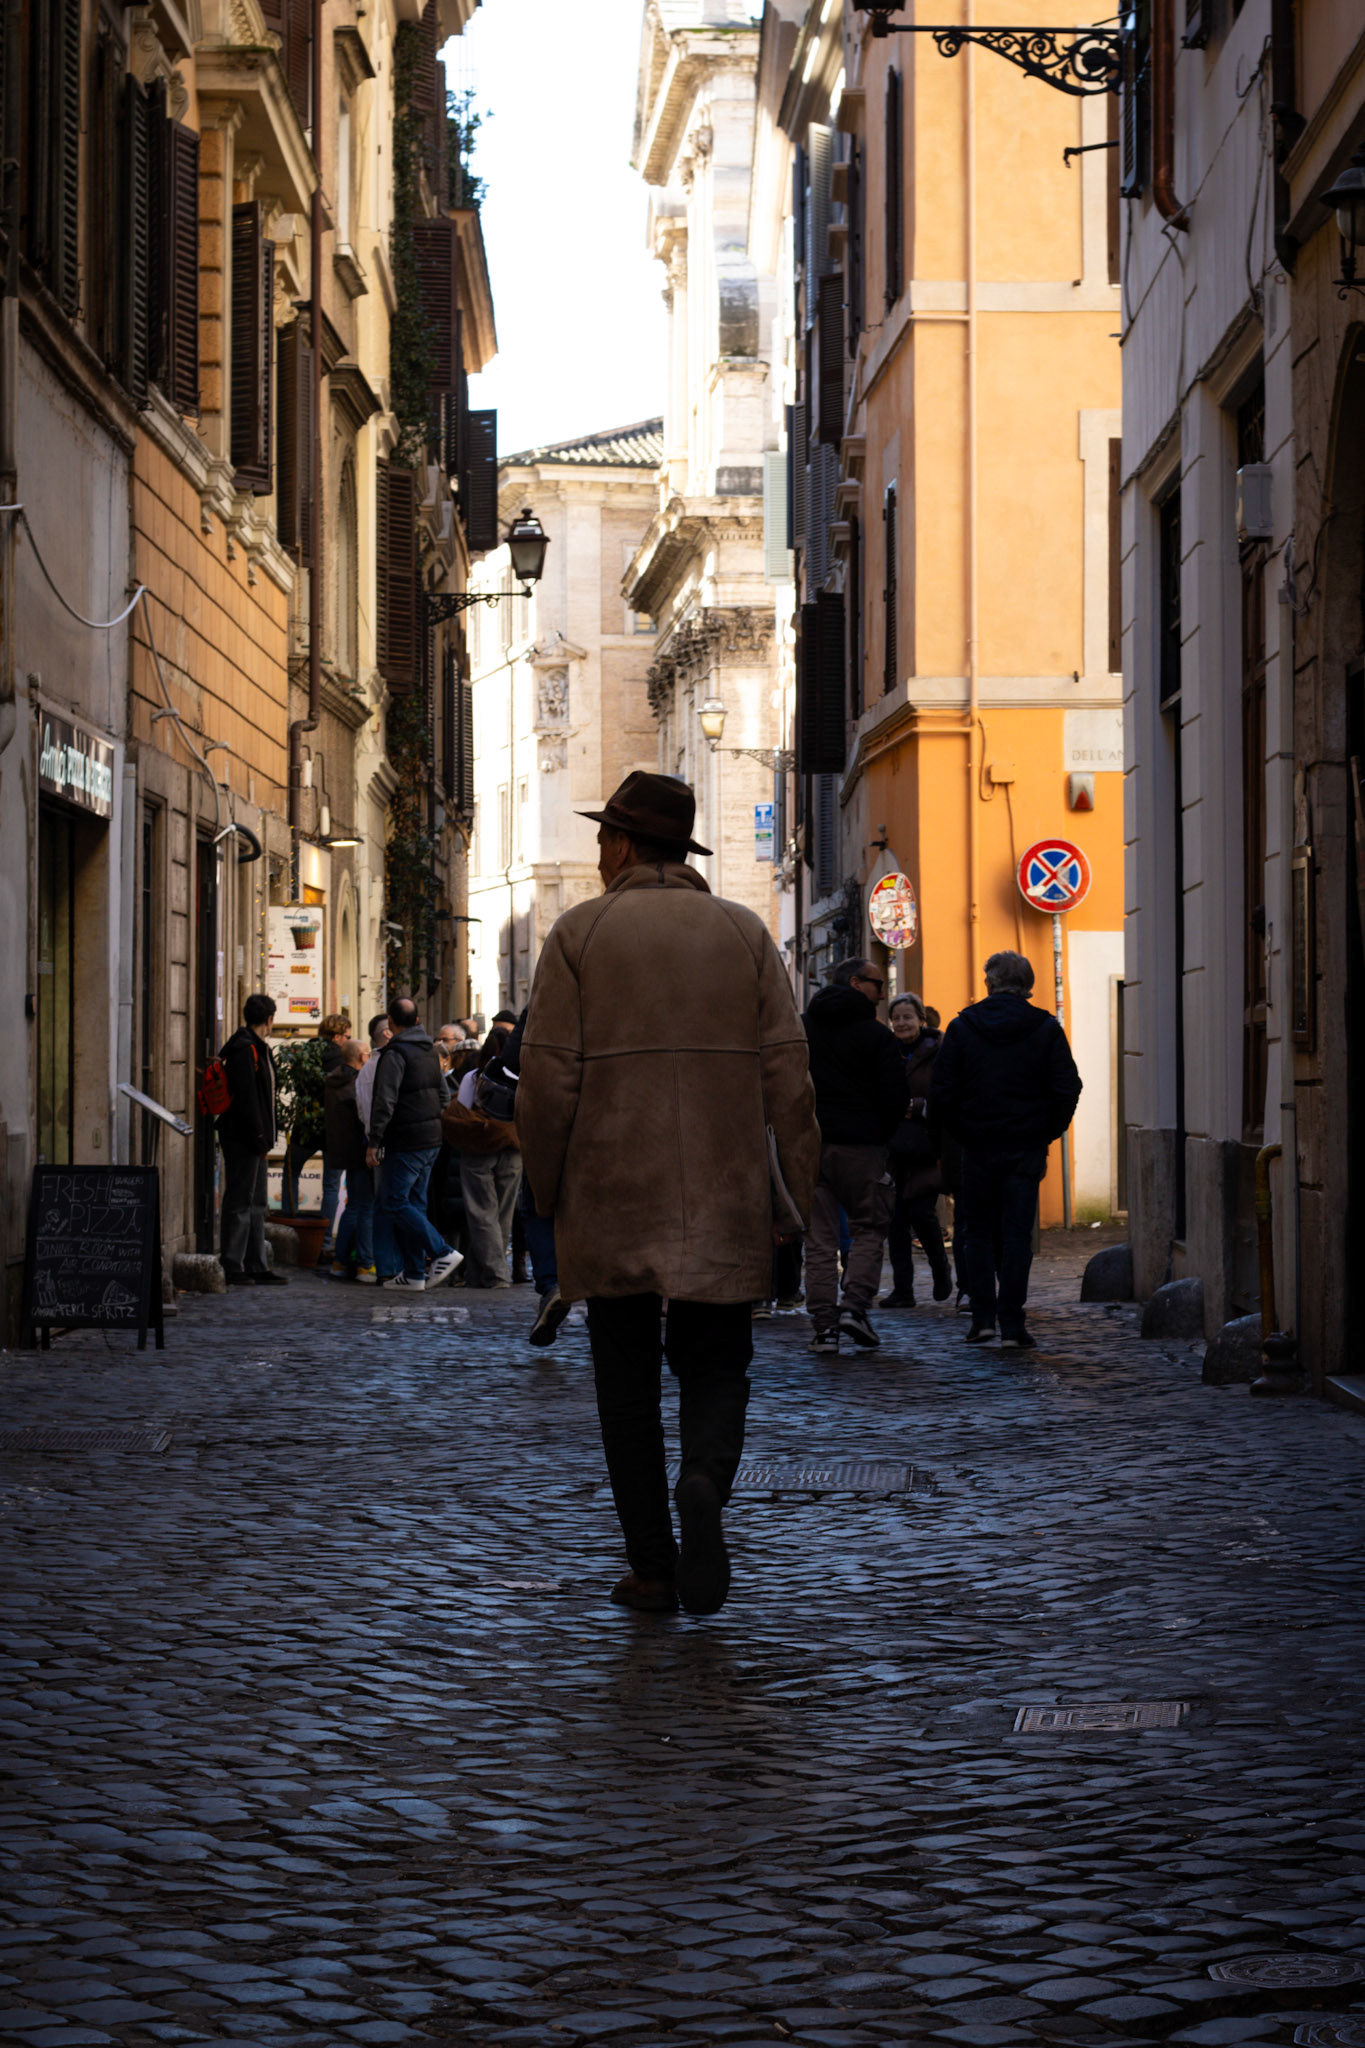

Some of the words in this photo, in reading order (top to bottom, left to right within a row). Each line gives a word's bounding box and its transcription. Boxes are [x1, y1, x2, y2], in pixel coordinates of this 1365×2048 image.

[40, 1175, 110, 1203] FRESH
[68, 1203, 141, 1235] PIZZA
[36, 1242, 74, 1258] DINING
[79, 1241, 115, 1255] ROOM
[92, 1303, 137, 1319] SPRITZ
